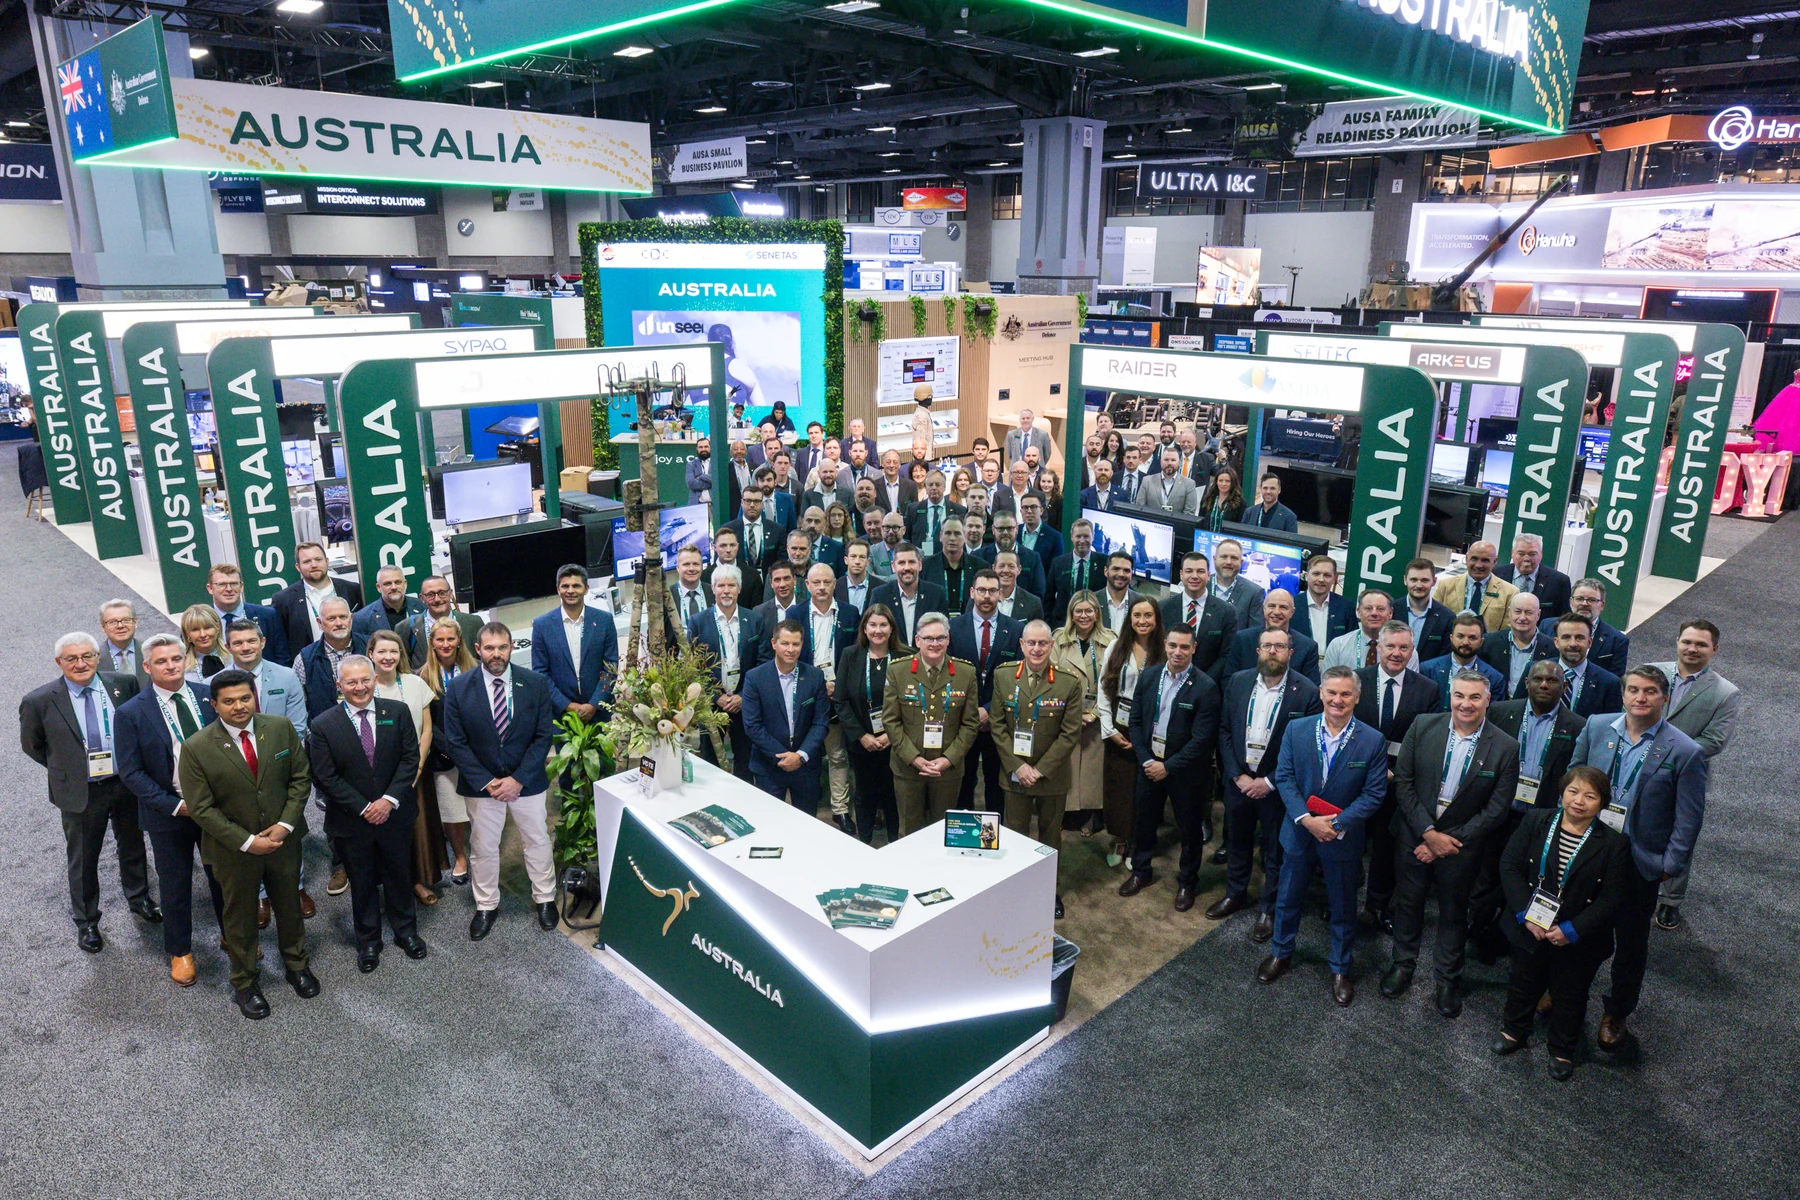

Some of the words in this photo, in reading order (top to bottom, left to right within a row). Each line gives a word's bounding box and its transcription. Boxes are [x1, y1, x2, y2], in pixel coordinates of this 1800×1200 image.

[1342, 110, 1382, 125] AUSA
[1386, 106, 1441, 123] FAMILY
[230, 111, 542, 166] AUSTRALIA
[1239, 123, 1279, 138] AUSA
[1316, 128, 1395, 145] READINESS
[1400, 122, 1472, 139] PAVILION
[692, 150, 710, 160] AUSA
[710, 147, 732, 158] SMALL
[681, 162, 712, 173] BUSINESS
[713, 159, 743, 170] PAVILION
[1151, 171, 1218, 192] ULTRA
[1227, 173, 1257, 193] I&C
[317, 194, 381, 206] INTERCONNECT
[382, 197, 426, 207] SOLUTIONS
[1430, 233, 1490, 242] TRANSFORMATION,
[1536, 233, 1577, 248] Hanwha
[756, 251, 798, 260] SENETAS
[658, 282, 777, 297] AUSTRALIA
[1027, 320, 1047, 329] Australian
[1047, 319, 1072, 328] Government
[444, 337, 507, 355] SYPAQ
[1018, 356, 1041, 364] MEETING
[1108, 358, 1177, 379] RAIDER
[1417, 353, 1492, 370] ARKEUS
[29, 323, 81, 490] AUSTRALIA
[70, 331, 126, 520] AUSTRALIA
[1286, 428, 1303, 437] Hiring
[1315, 432, 1336, 440] Heroes
[1670, 347, 1731, 544] AUSTRALIA
[139, 347, 200, 568] AUSTRALIA
[1597, 360, 1663, 587] AUSTRALIA
[227, 369, 289, 606] USTRALIA
[691, 933, 784, 1008] AUSTRALIA
